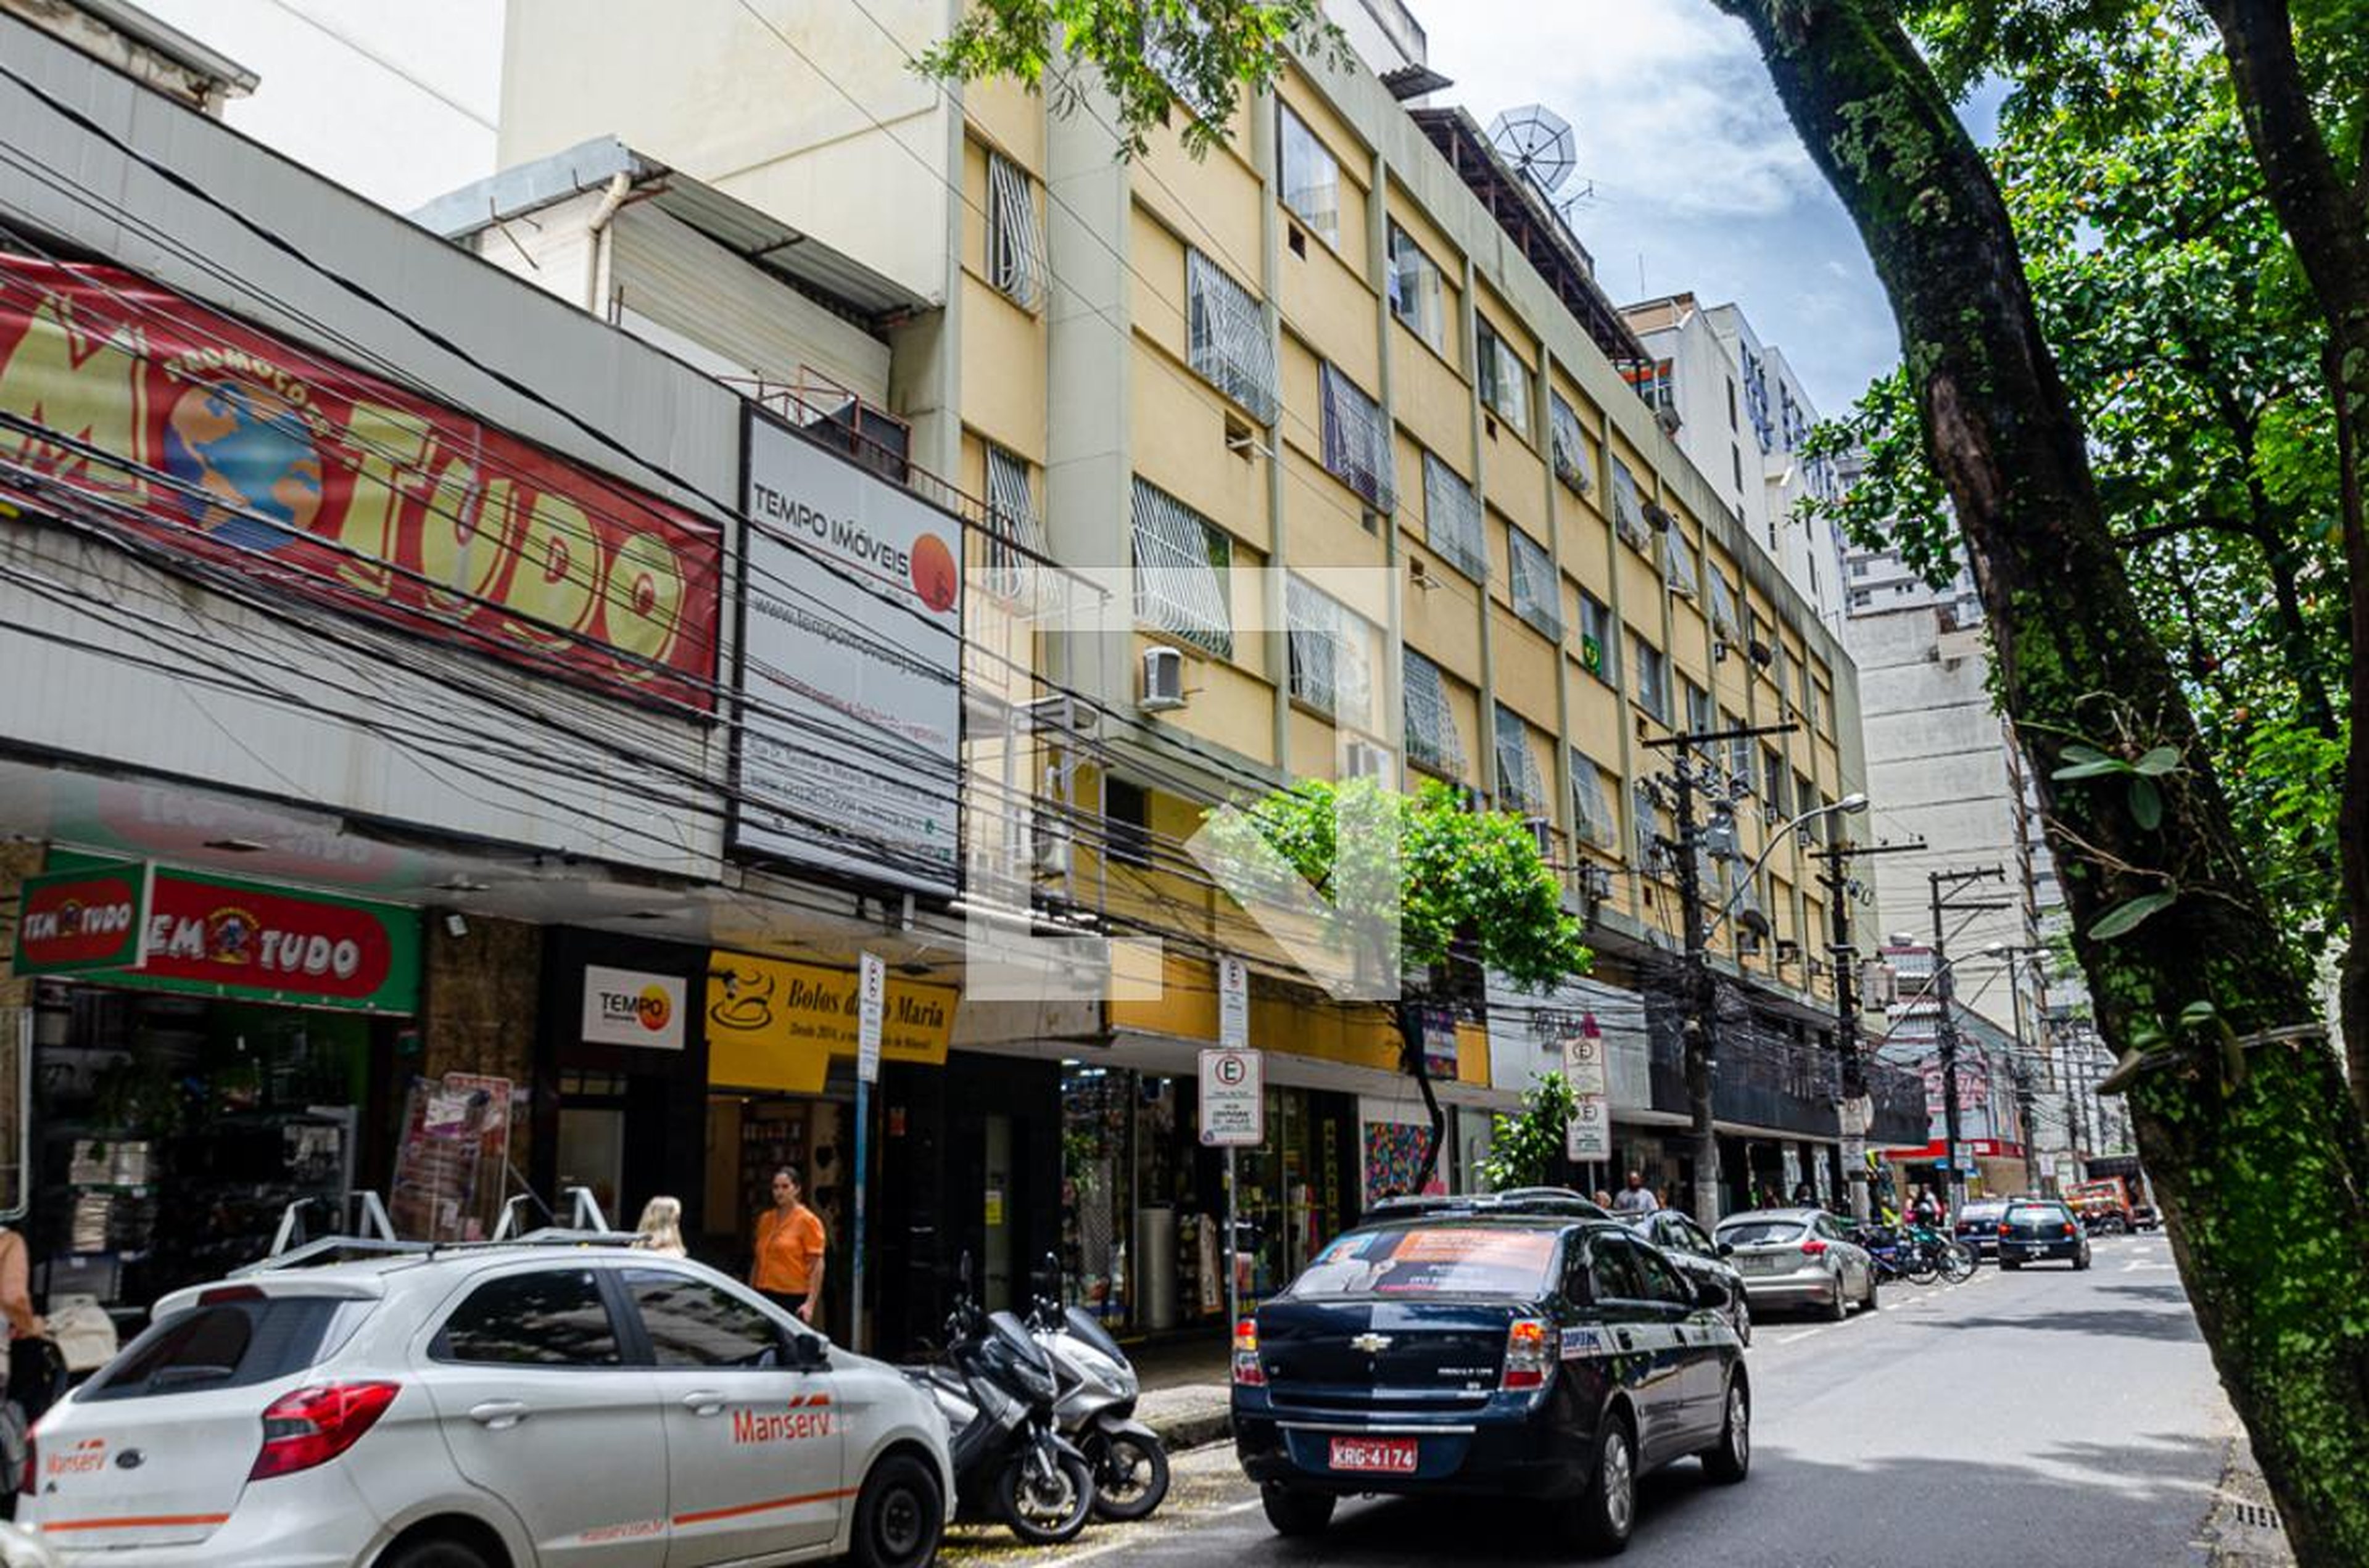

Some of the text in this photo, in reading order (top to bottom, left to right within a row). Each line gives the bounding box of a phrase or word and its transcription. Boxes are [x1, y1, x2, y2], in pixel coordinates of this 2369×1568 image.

[754, 483, 827, 537] TEMPO
[337, 401, 686, 683] TUDO
[23, 902, 131, 940] TEM TUDO
[146, 914, 206, 960] EM
[260, 930, 360, 980] TUDO
[599, 991, 663, 1017] TEMPO
[788, 978, 839, 1013] Bolos
[844, 988, 861, 1017] d
[899, 996, 945, 1029] Maria
[1224, 1060, 1237, 1080] E
[734, 1407, 830, 1443] Manserv
